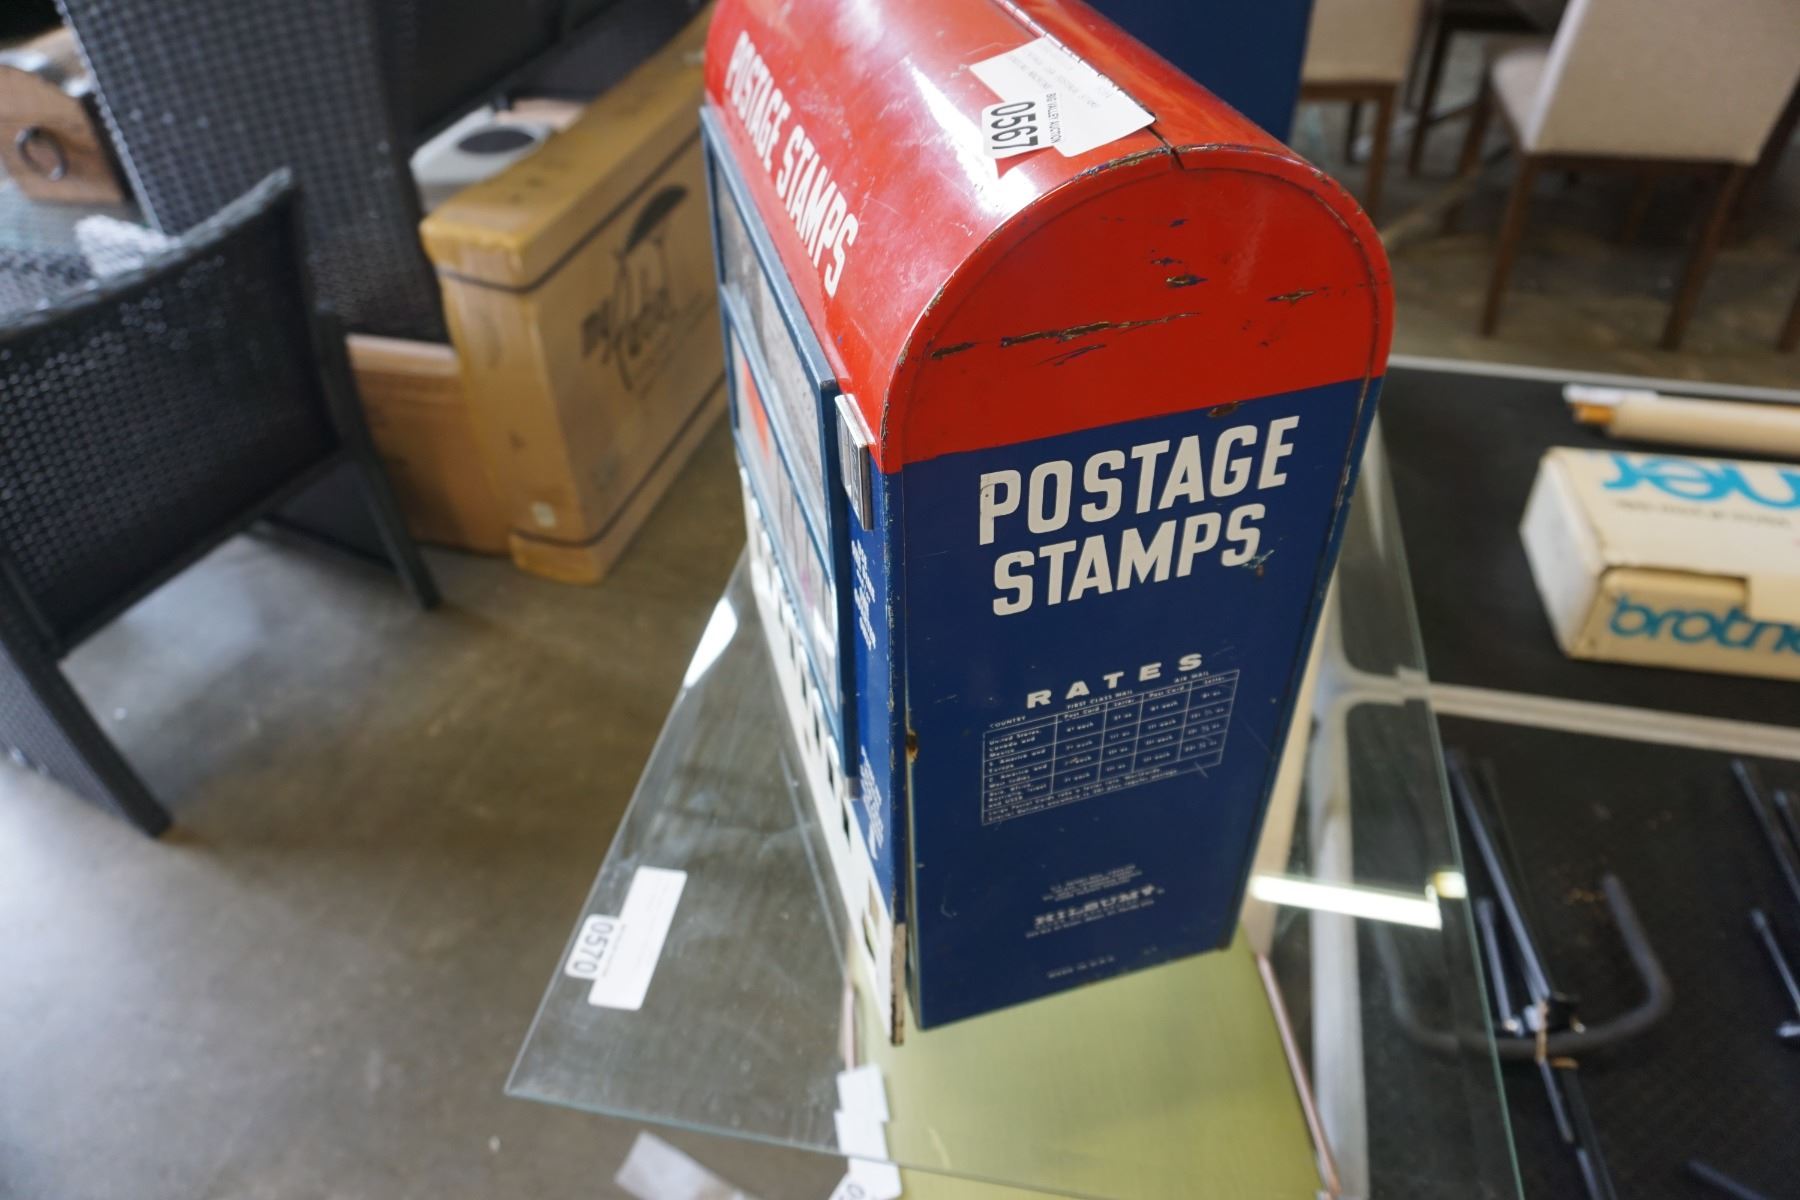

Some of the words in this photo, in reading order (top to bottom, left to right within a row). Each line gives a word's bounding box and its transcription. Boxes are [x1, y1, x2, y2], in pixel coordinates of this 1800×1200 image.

[725, 30, 791, 173] POSTAGE
[775, 124, 859, 298] STAMPS
[991, 101, 1039, 150] 0567
[979, 415, 1300, 545] POSTAGE
[993, 503, 1265, 616] STAMPS
[1027, 653, 1203, 709] RATES
[572, 921, 614, 974] 0570
